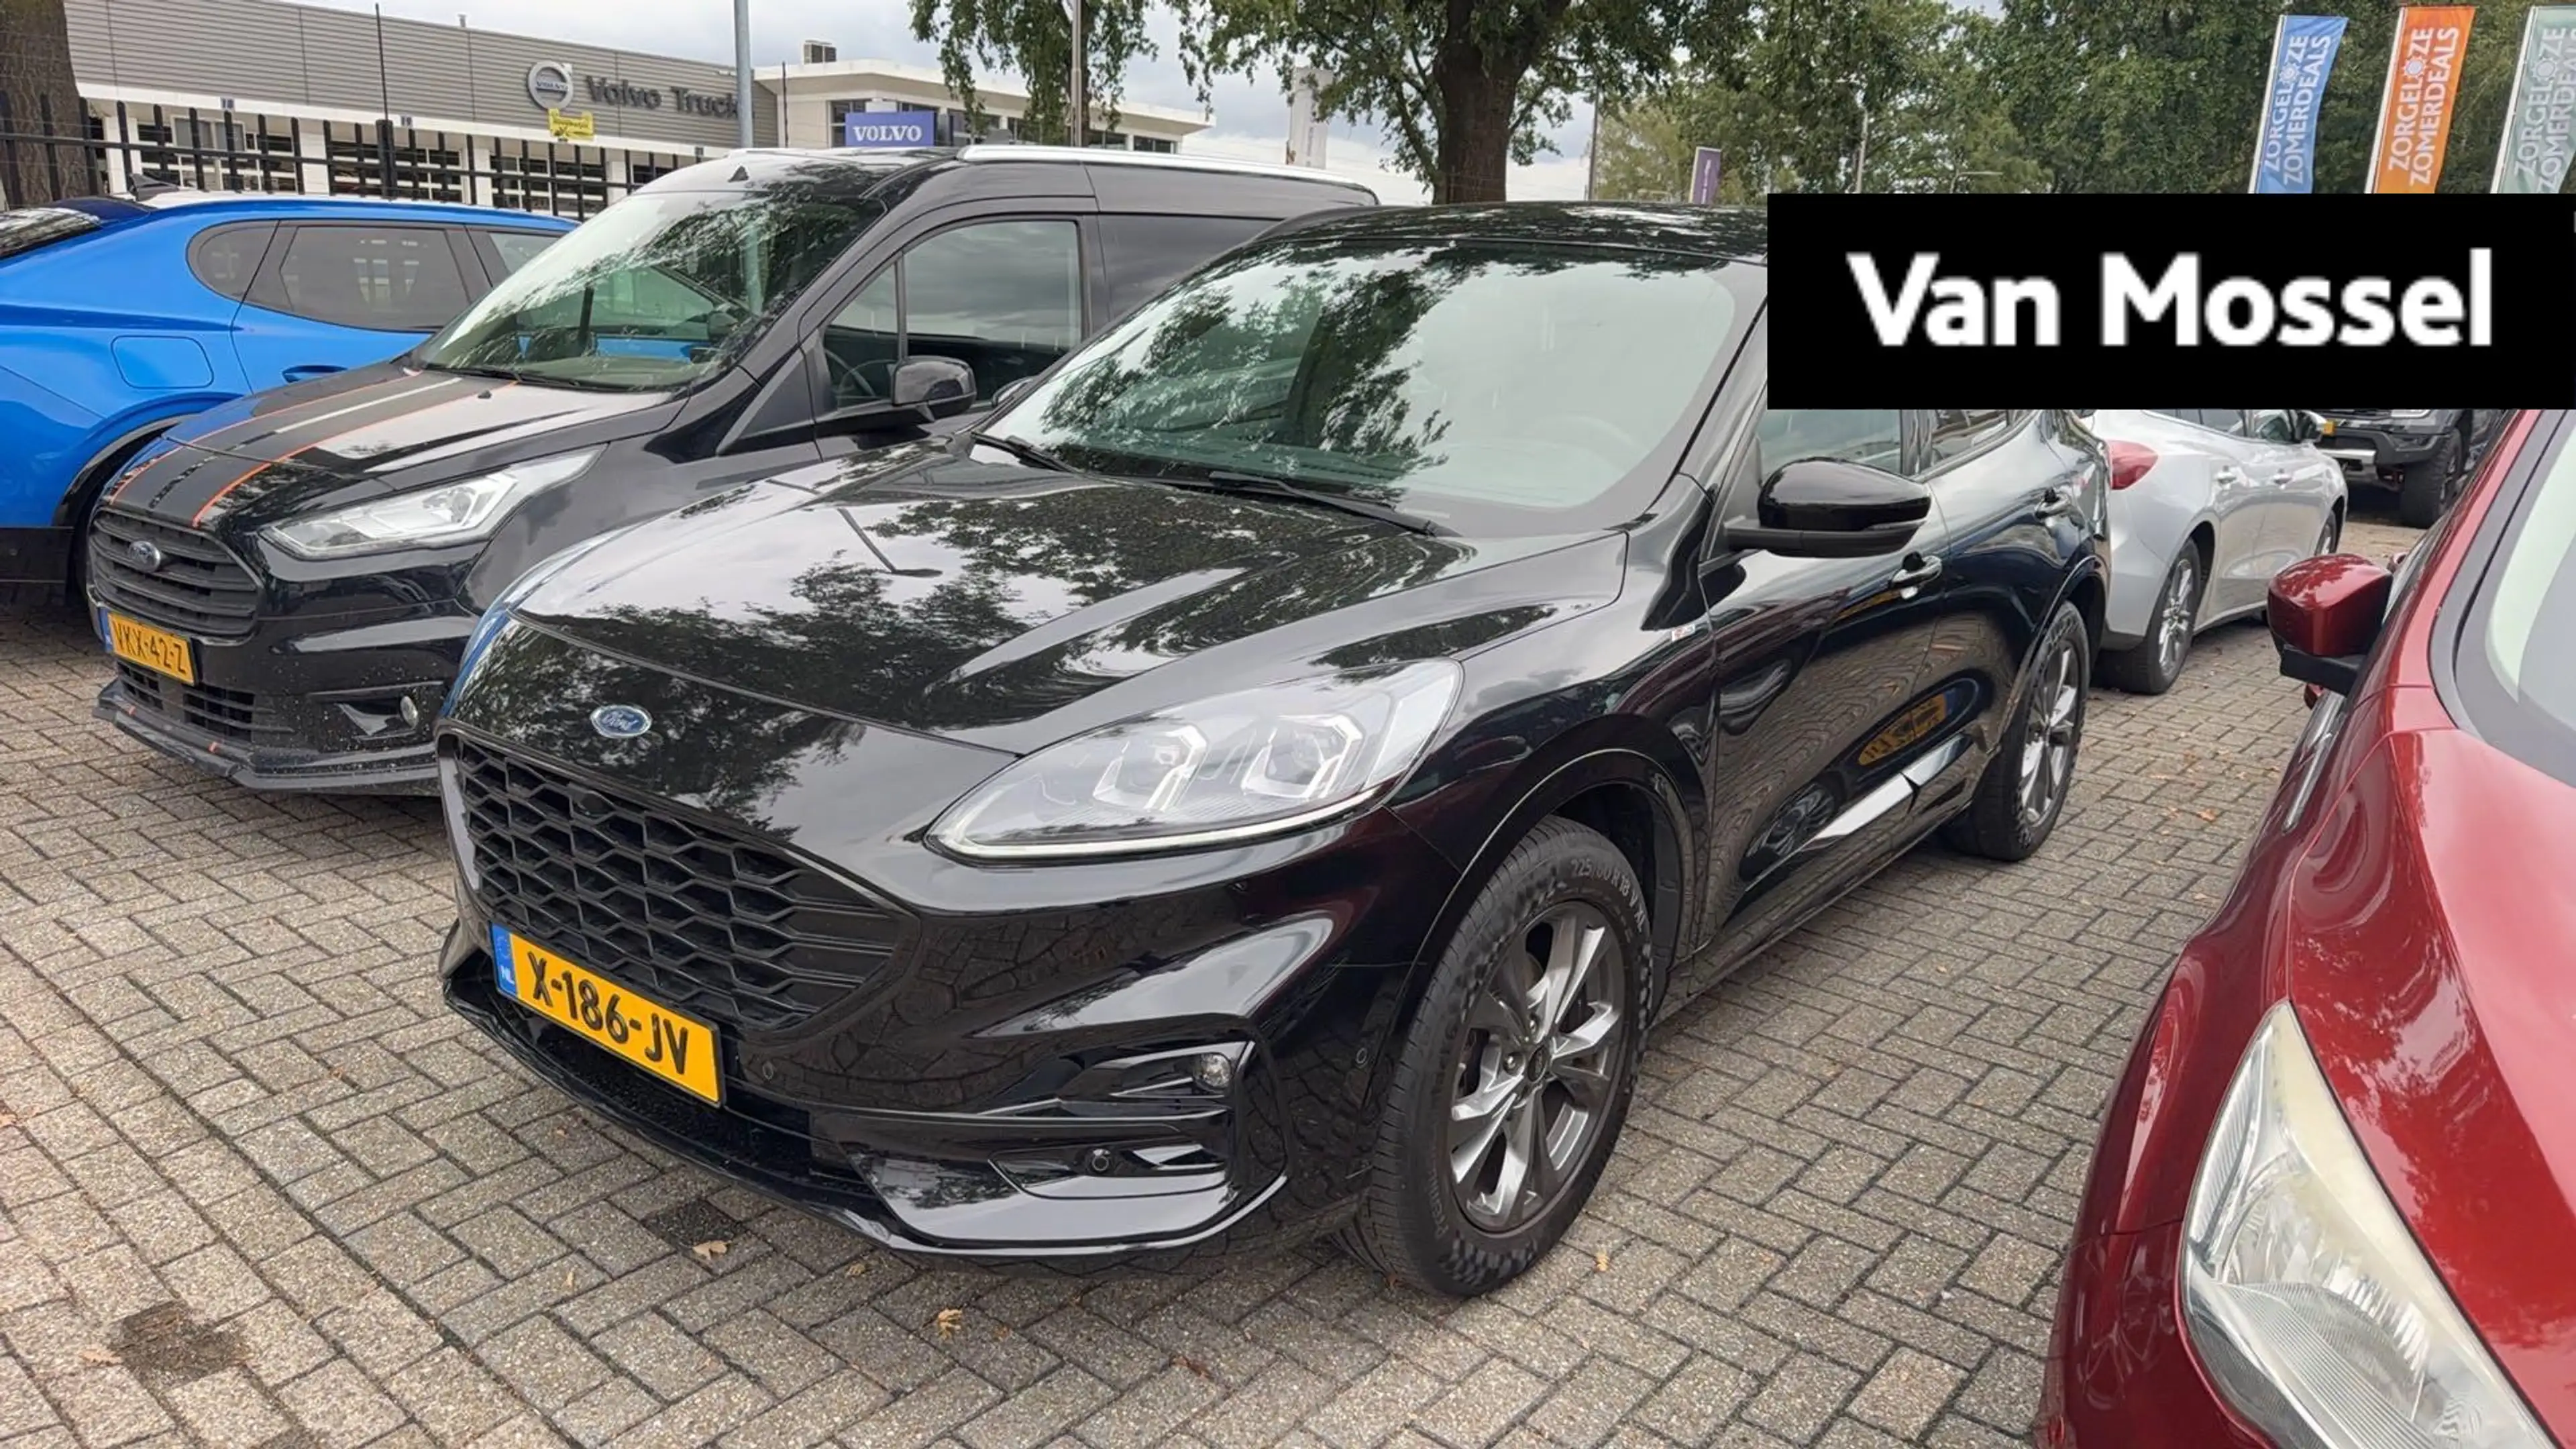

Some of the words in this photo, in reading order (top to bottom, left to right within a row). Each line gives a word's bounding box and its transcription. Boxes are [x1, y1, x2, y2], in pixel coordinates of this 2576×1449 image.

[585, 75, 662, 109] Volvo
[670, 86, 739, 118] Truck
[853, 125, 922, 142] VOLVO
[2283, 35, 2331, 184] ZOMERDEALS
[2409, 27, 2459, 186] ZOMERDEALS
[527, 951, 688, 1075] X-186-JV
